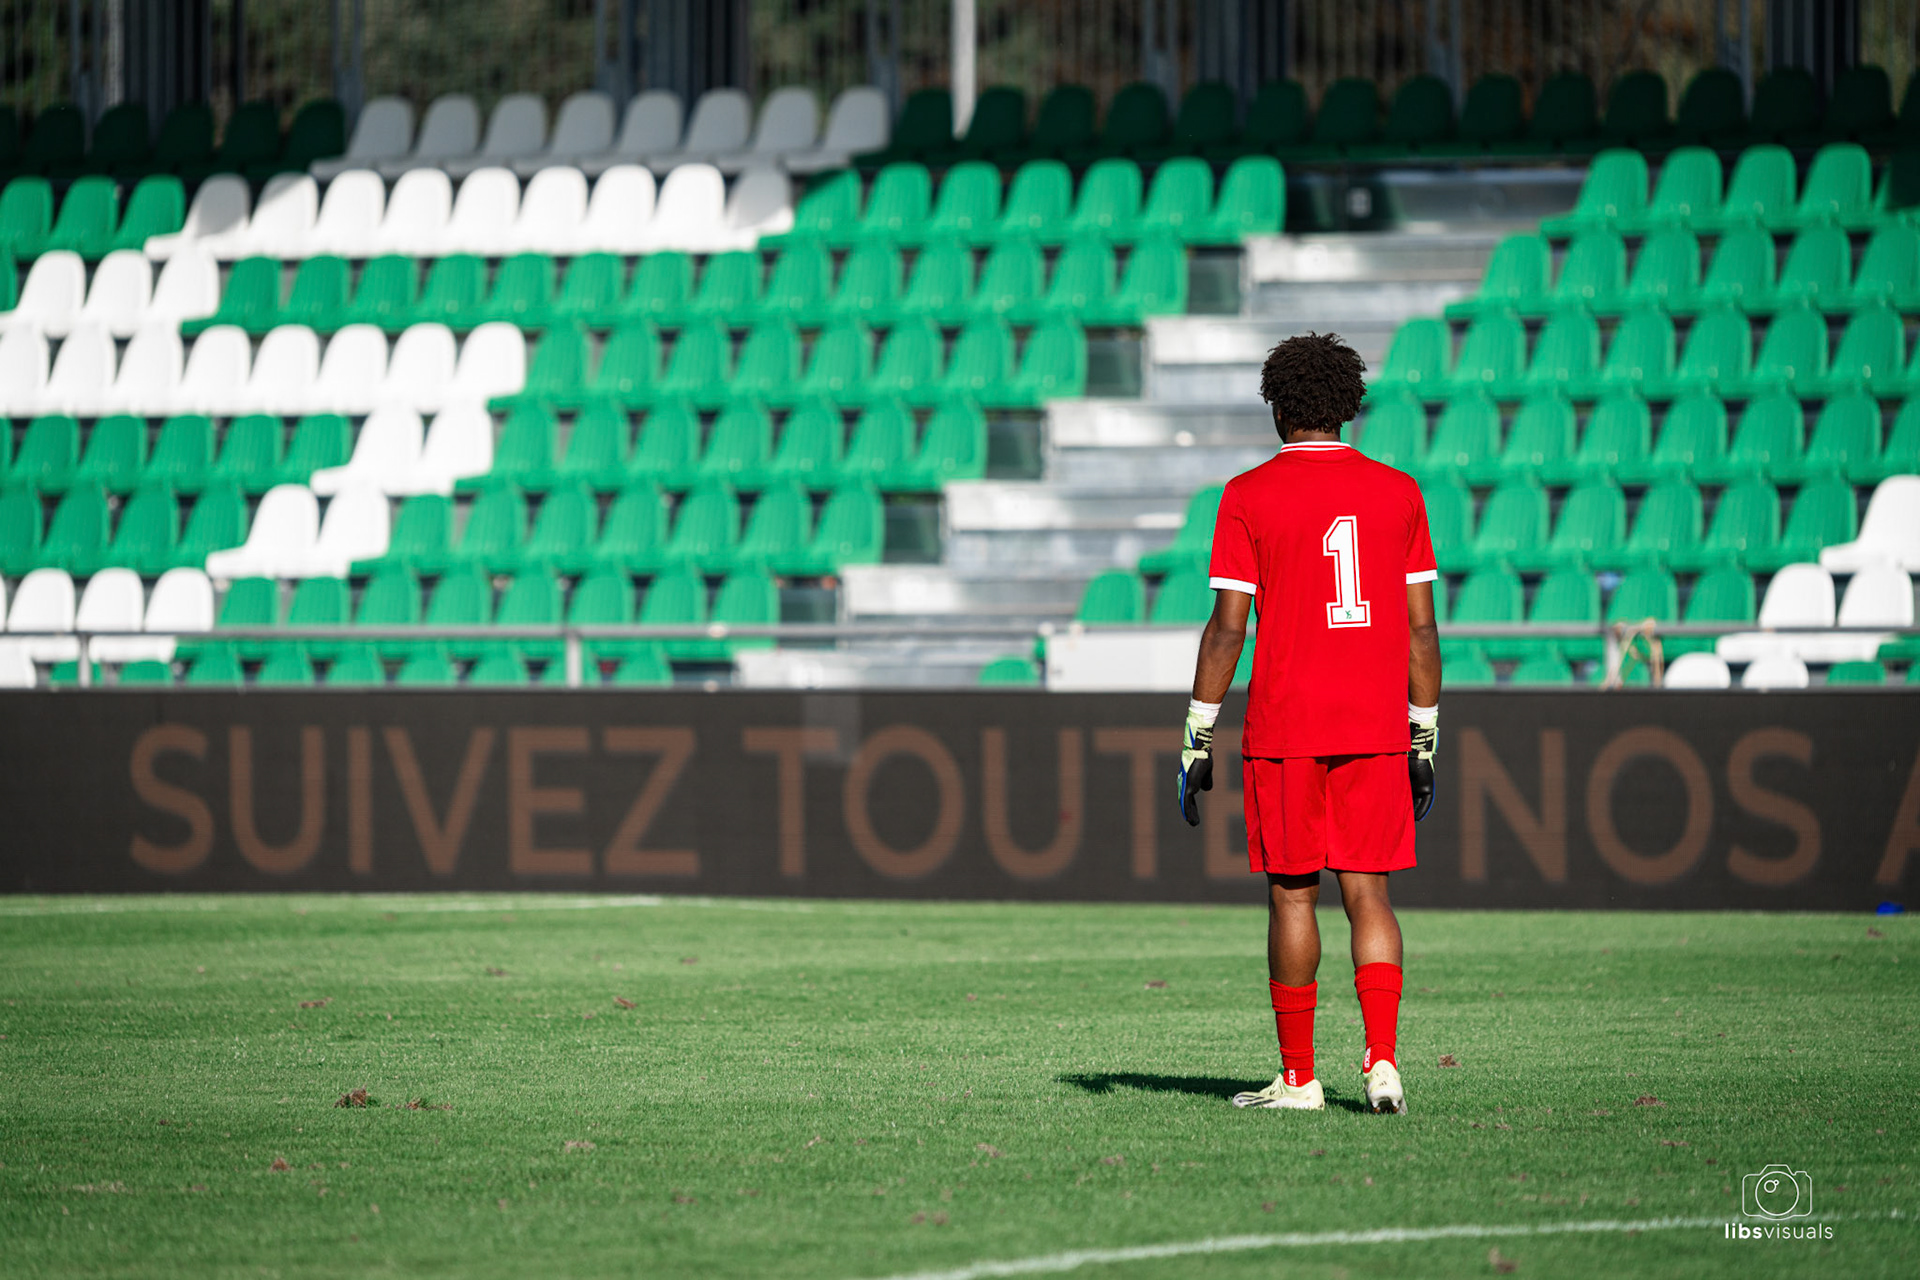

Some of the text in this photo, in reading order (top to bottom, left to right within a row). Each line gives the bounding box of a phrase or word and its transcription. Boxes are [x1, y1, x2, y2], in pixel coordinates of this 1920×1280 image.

[1323, 515, 1371, 629] 1
[130, 723, 700, 877] SUIVEZ
[1459, 726, 1821, 886] NOS
